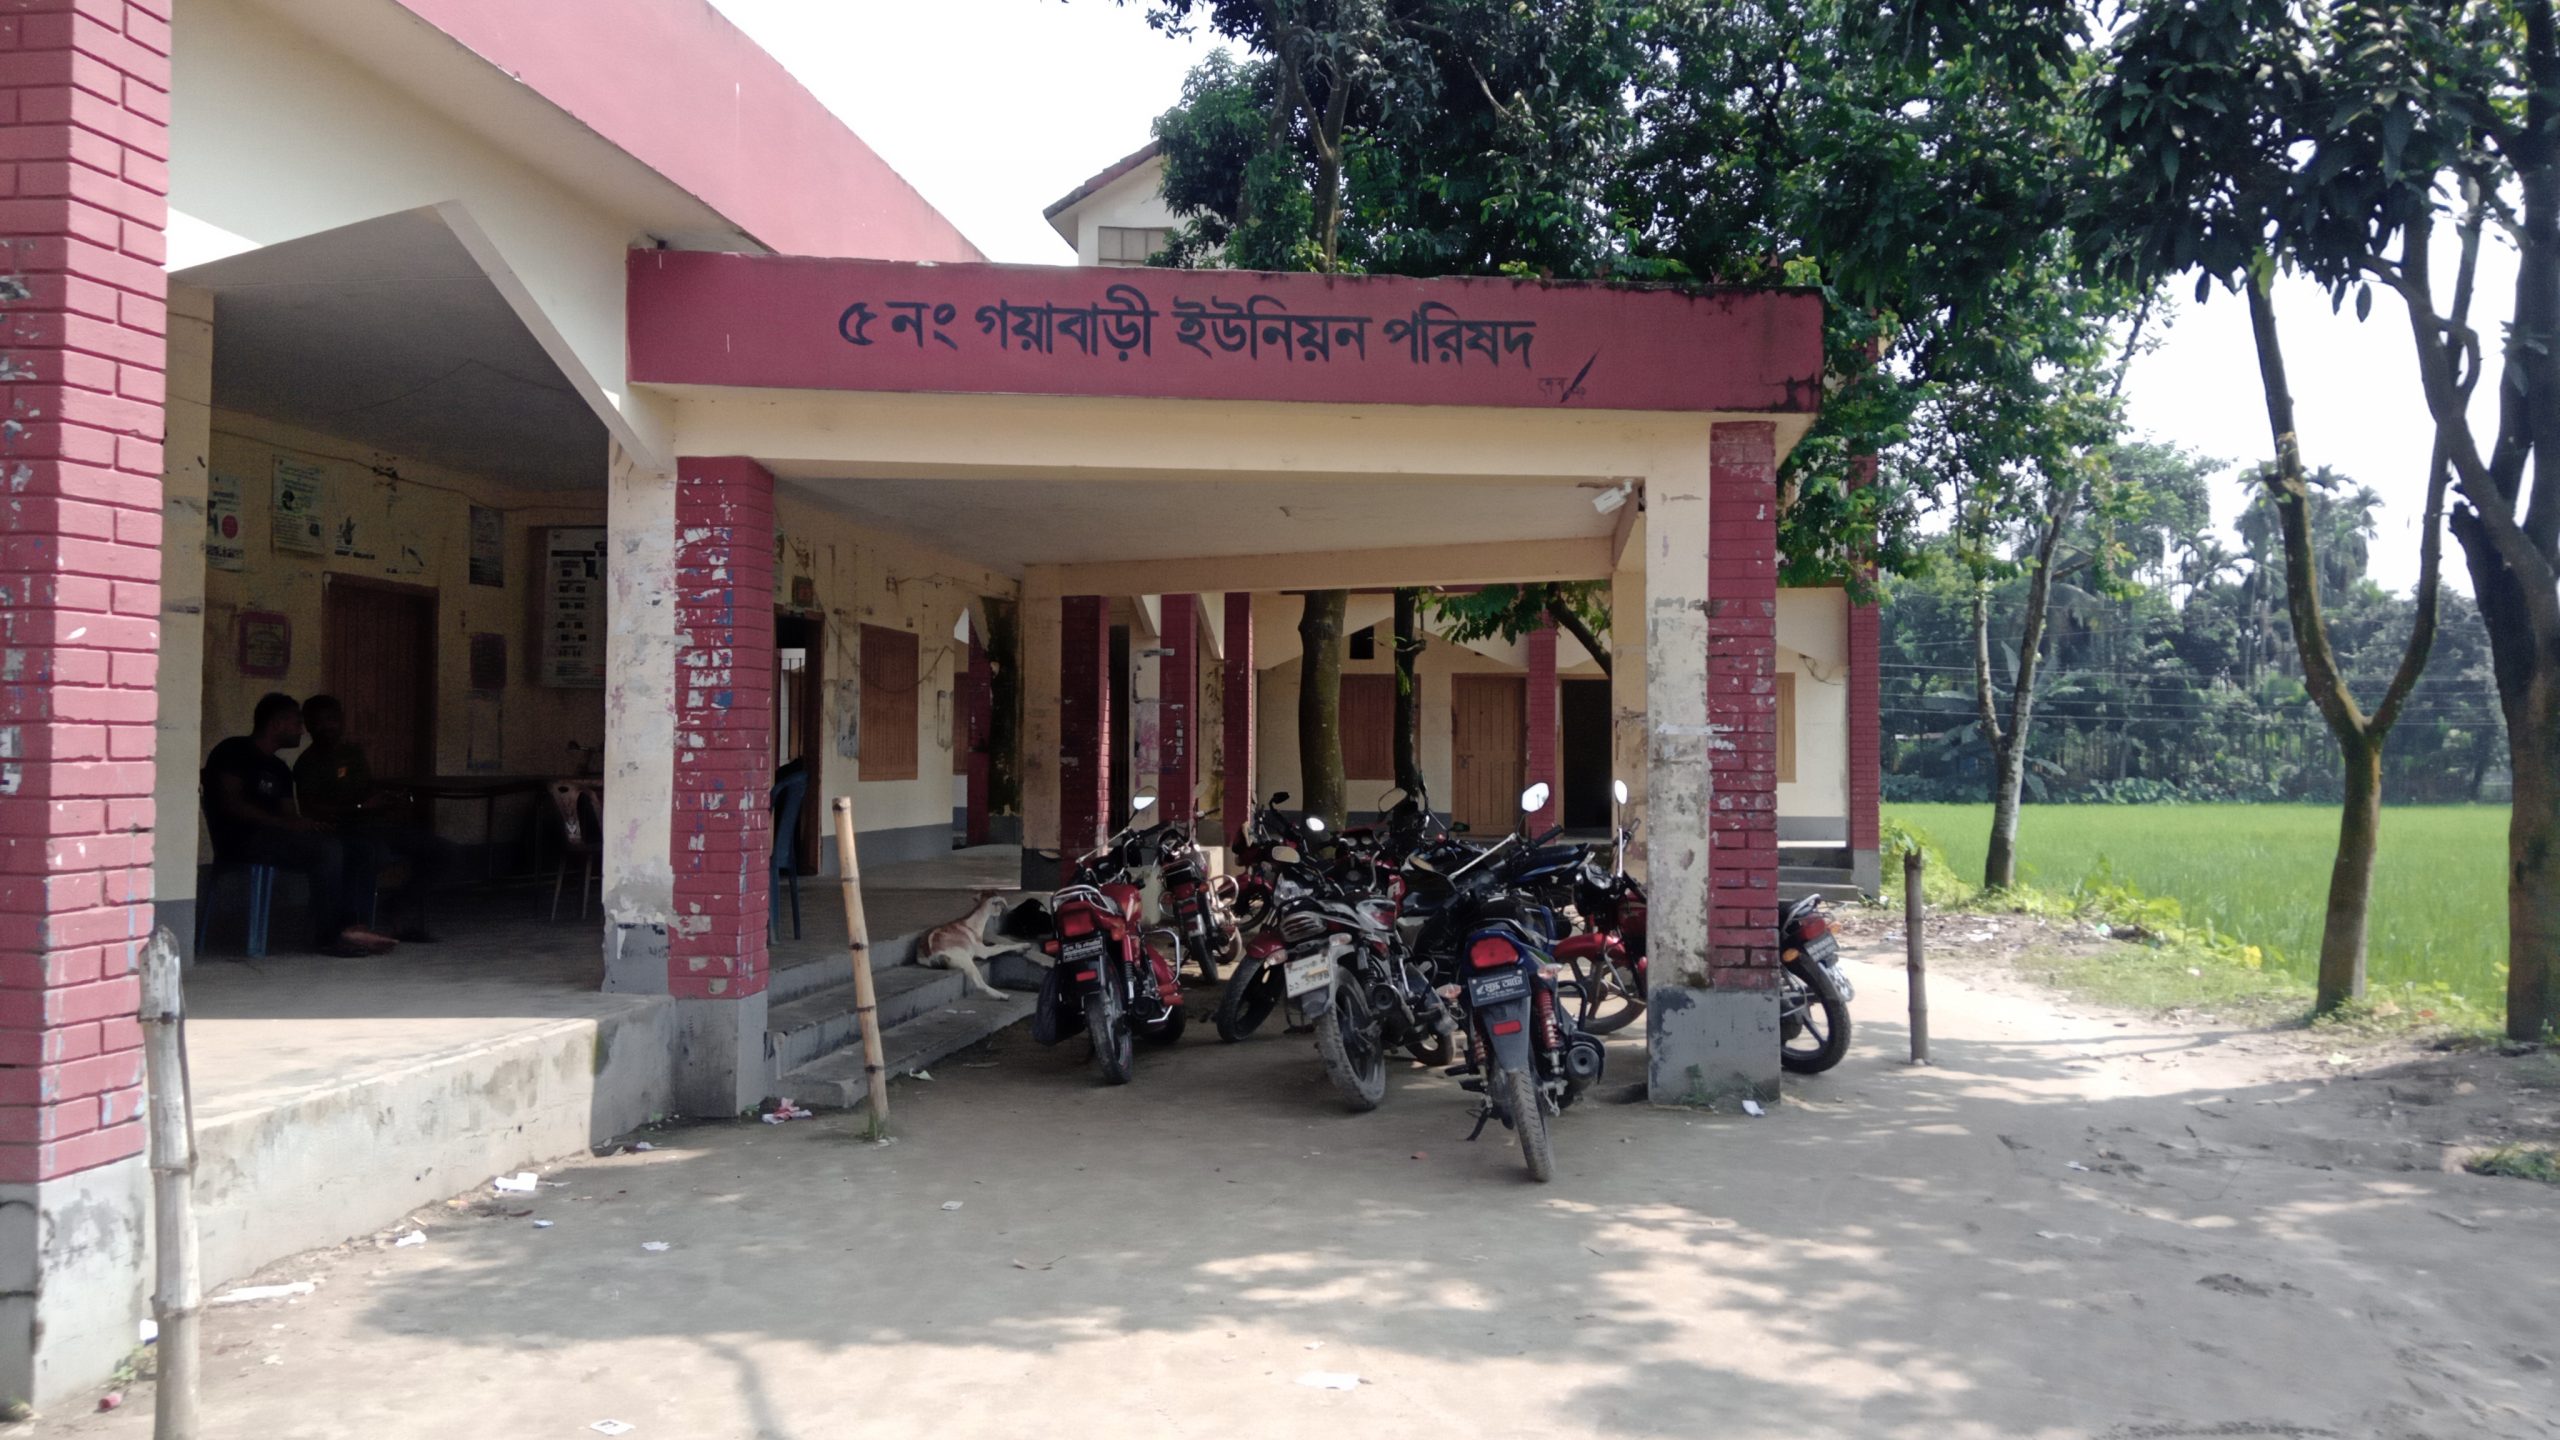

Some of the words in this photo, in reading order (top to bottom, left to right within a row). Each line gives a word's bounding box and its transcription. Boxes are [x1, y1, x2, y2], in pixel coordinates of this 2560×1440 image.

[838, 302, 877, 346] ৫
[886, 301, 957, 348] নং
[975, 284, 1160, 362] গয়াবাড়ী
[1172, 294, 1373, 362] ইউনিয়ন
[1382, 300, 1537, 369] পরিষদ
